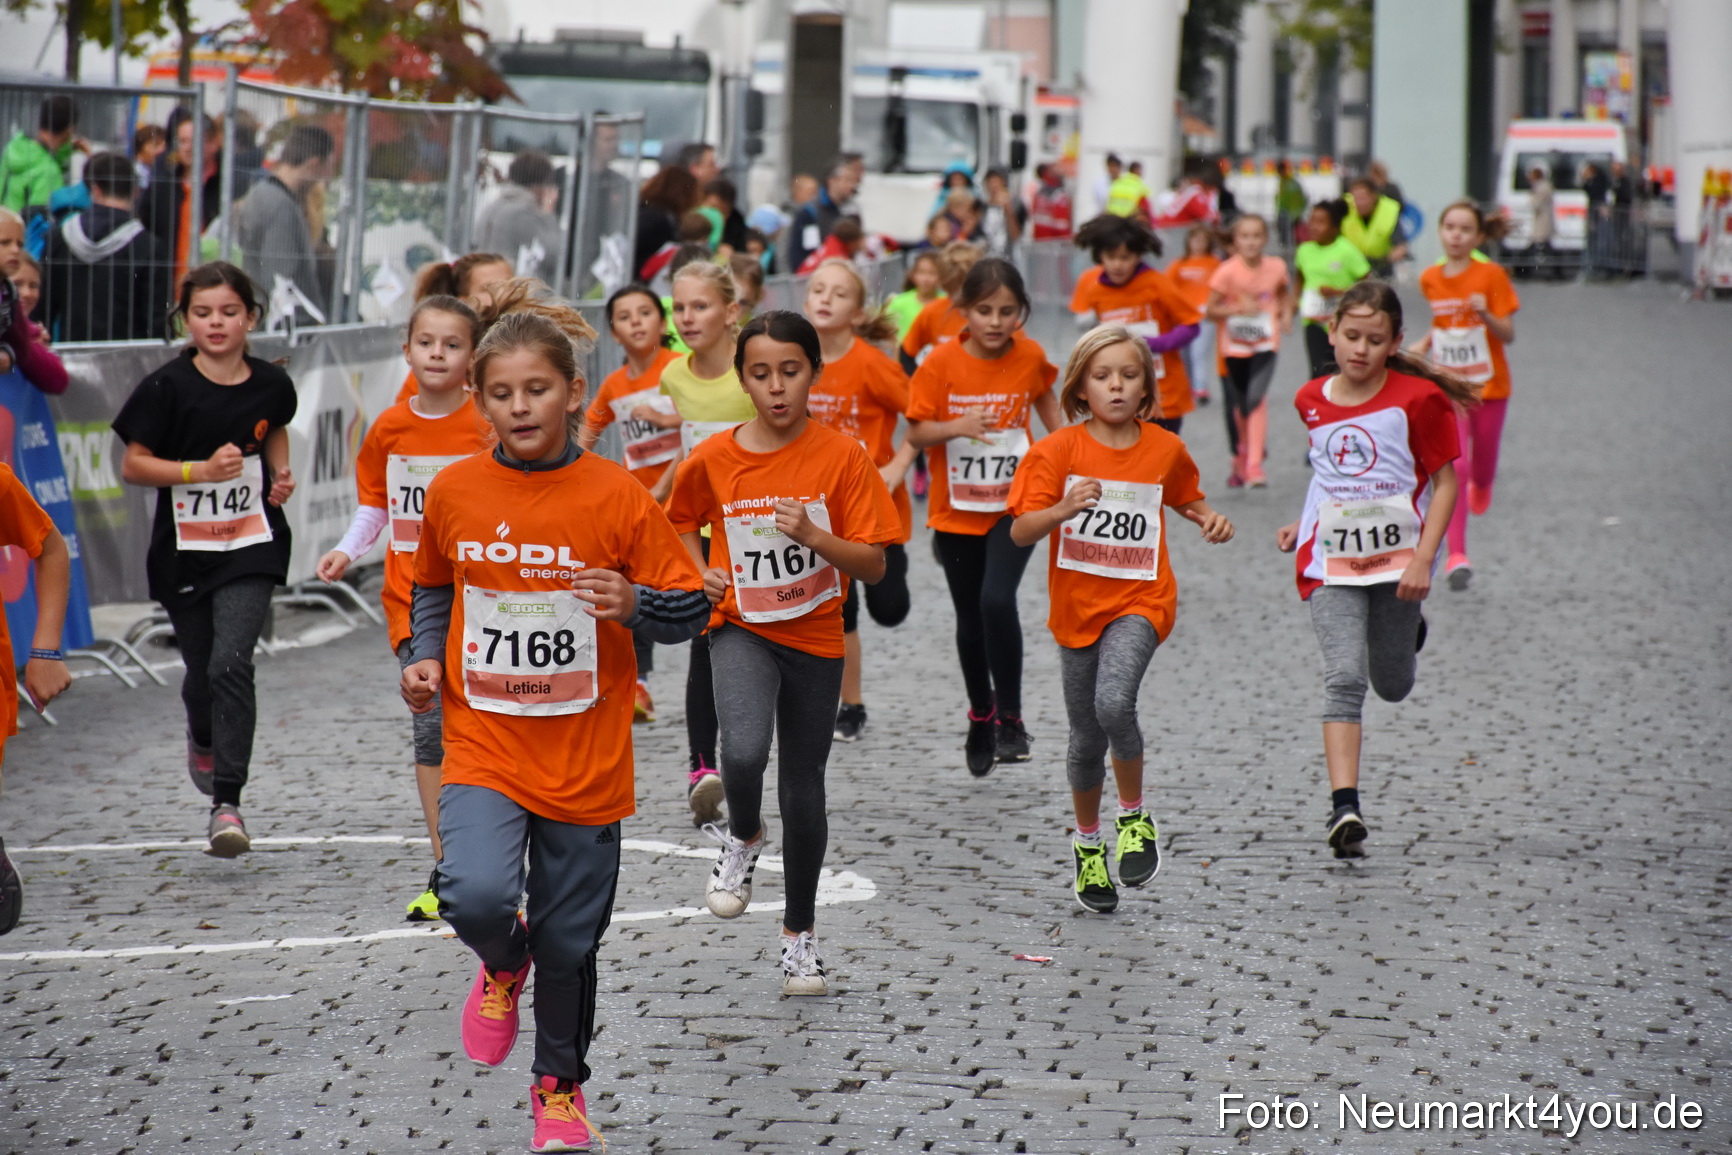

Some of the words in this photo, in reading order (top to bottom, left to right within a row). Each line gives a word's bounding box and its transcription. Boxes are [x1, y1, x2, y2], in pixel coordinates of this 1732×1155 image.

[1442, 345, 1478, 362] 7101
[960, 456, 1018, 480] 7173
[187, 485, 251, 516] 7142
[400, 486, 426, 514] 70
[211, 526, 236, 536] Luisa
[1078, 508, 1147, 541] 7280
[1333, 524, 1401, 552] 7118
[744, 544, 816, 581] 7167
[1072, 541, 1155, 566] JOHANNA
[1350, 557, 1392, 571] Charlotte
[776, 586, 805, 602] Sofia
[510, 603, 556, 614] BOCK
[482, 627, 576, 668] 7168
[467, 657, 477, 665] B5
[505, 681, 551, 694] Leticia
